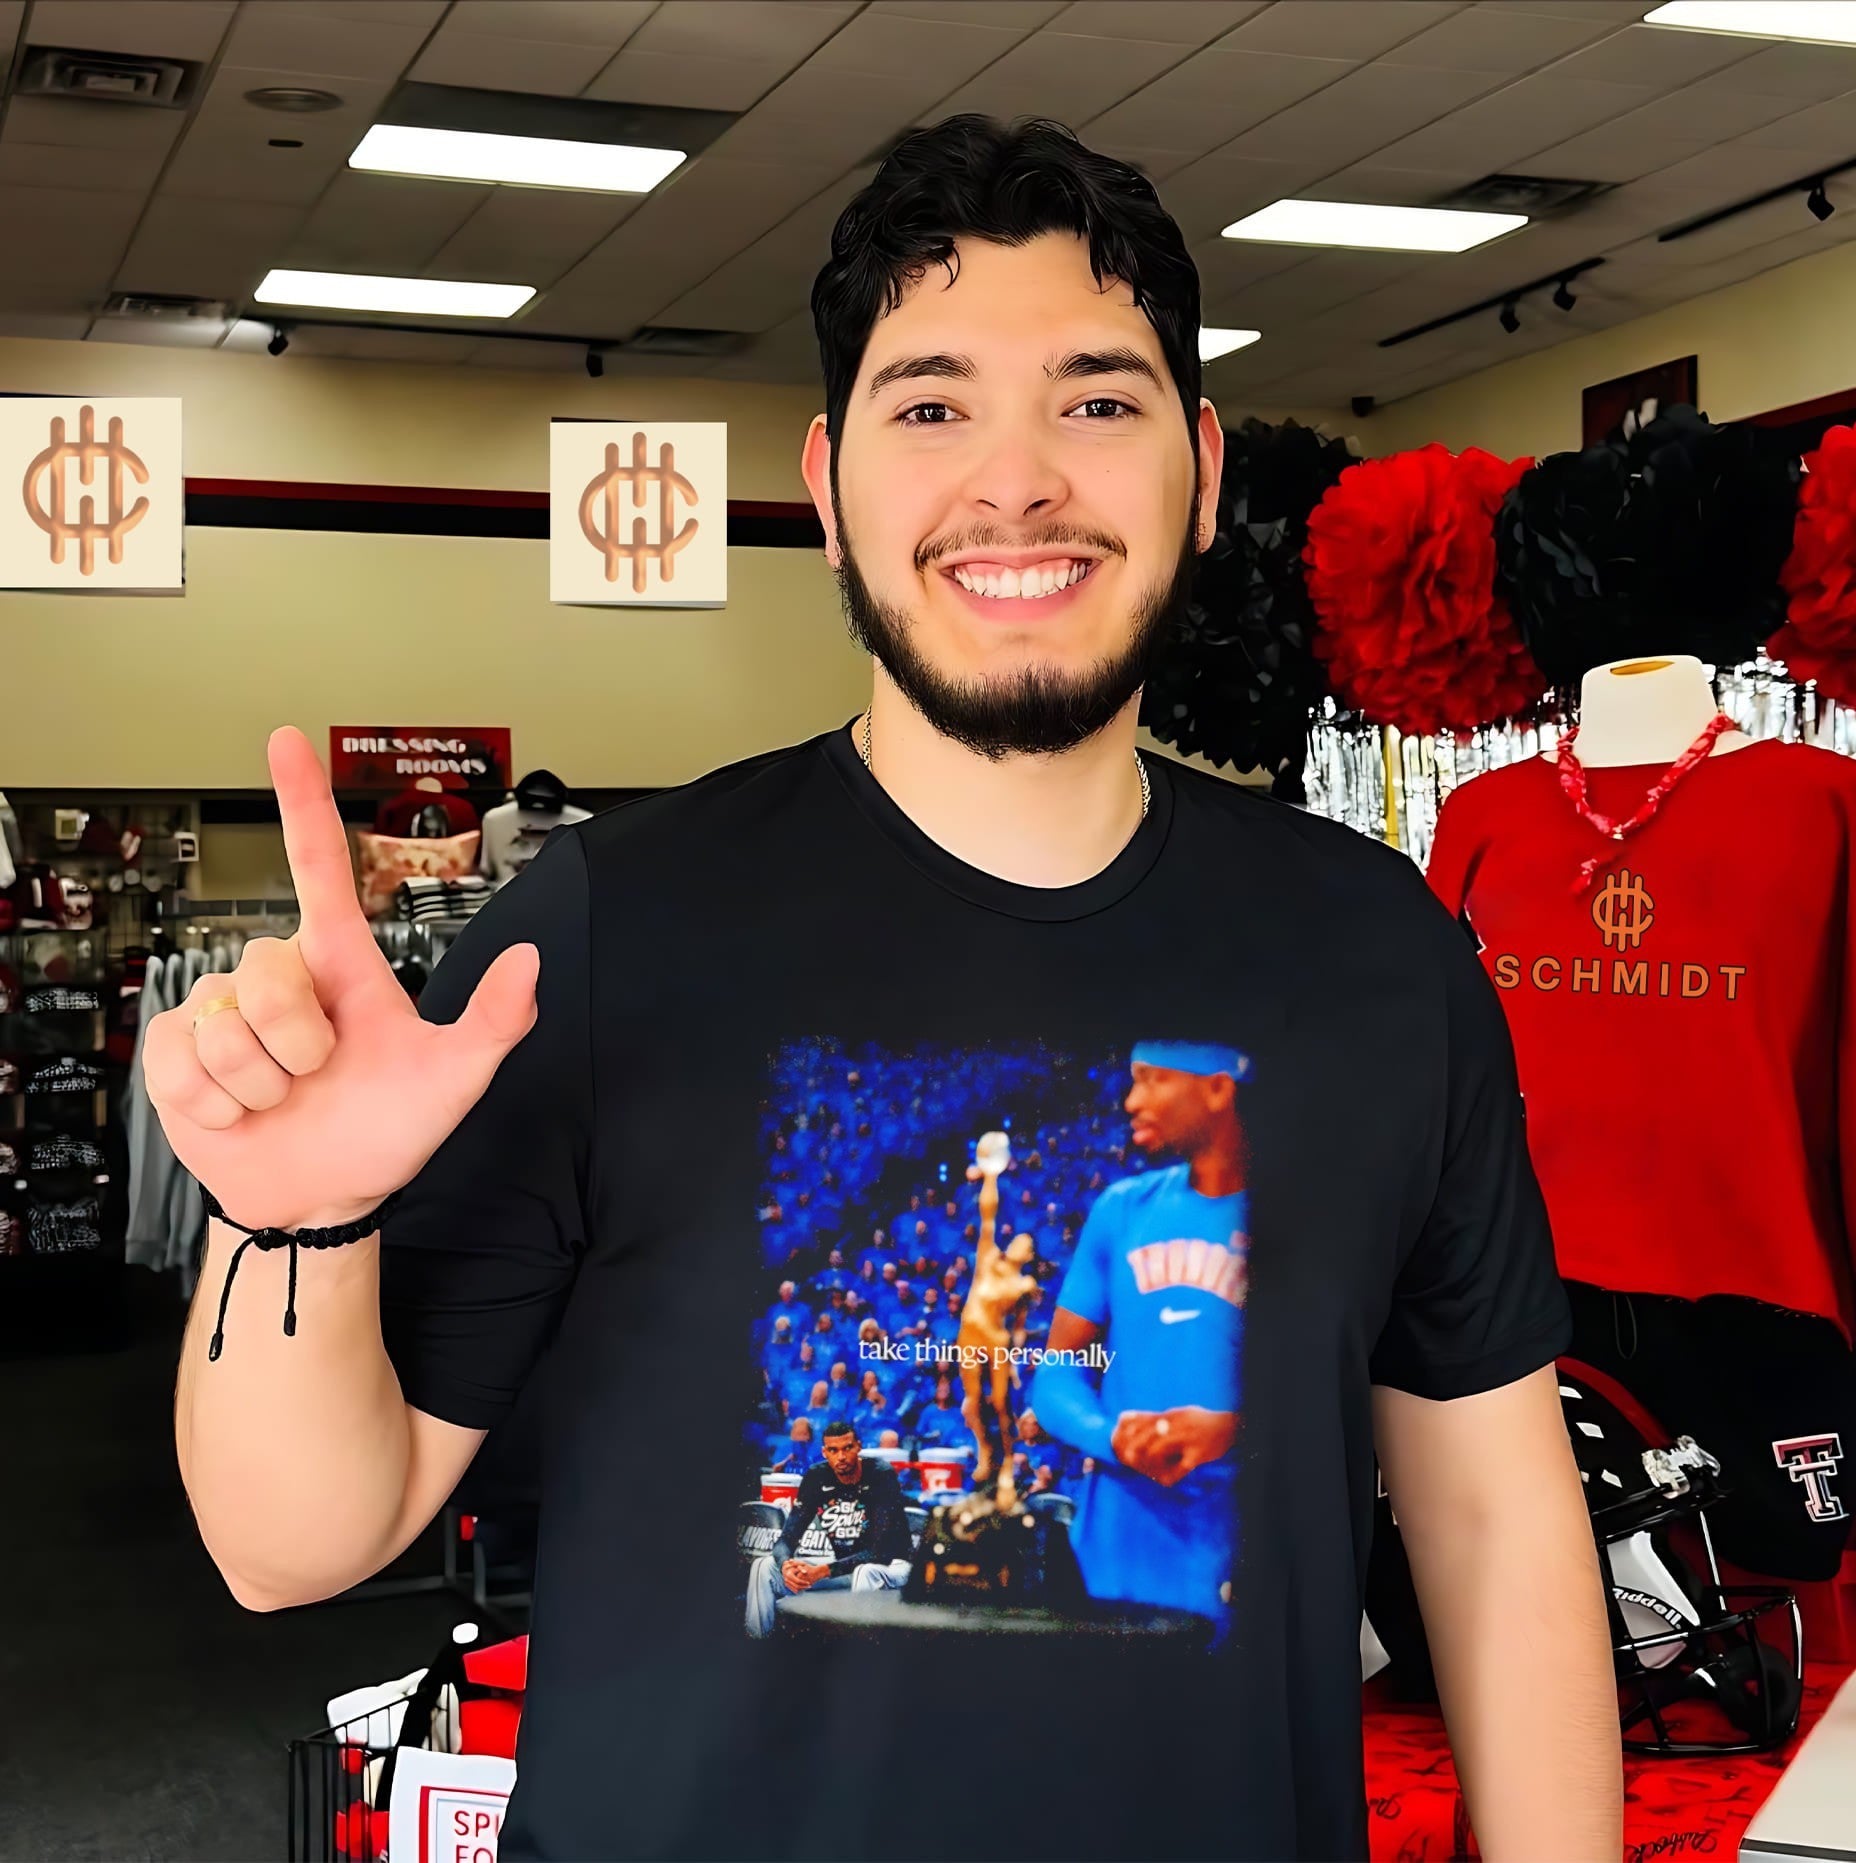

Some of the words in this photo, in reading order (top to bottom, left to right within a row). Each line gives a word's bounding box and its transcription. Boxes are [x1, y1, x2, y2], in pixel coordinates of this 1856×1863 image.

[342, 737, 466, 753] DRESSING
[396, 758, 487, 775] ROOMS
[1494, 953, 1747, 1000] SCHMIDT
[858, 1336, 910, 1361] take
[914, 1337, 988, 1369] things
[993, 1342, 1116, 1374] personally
